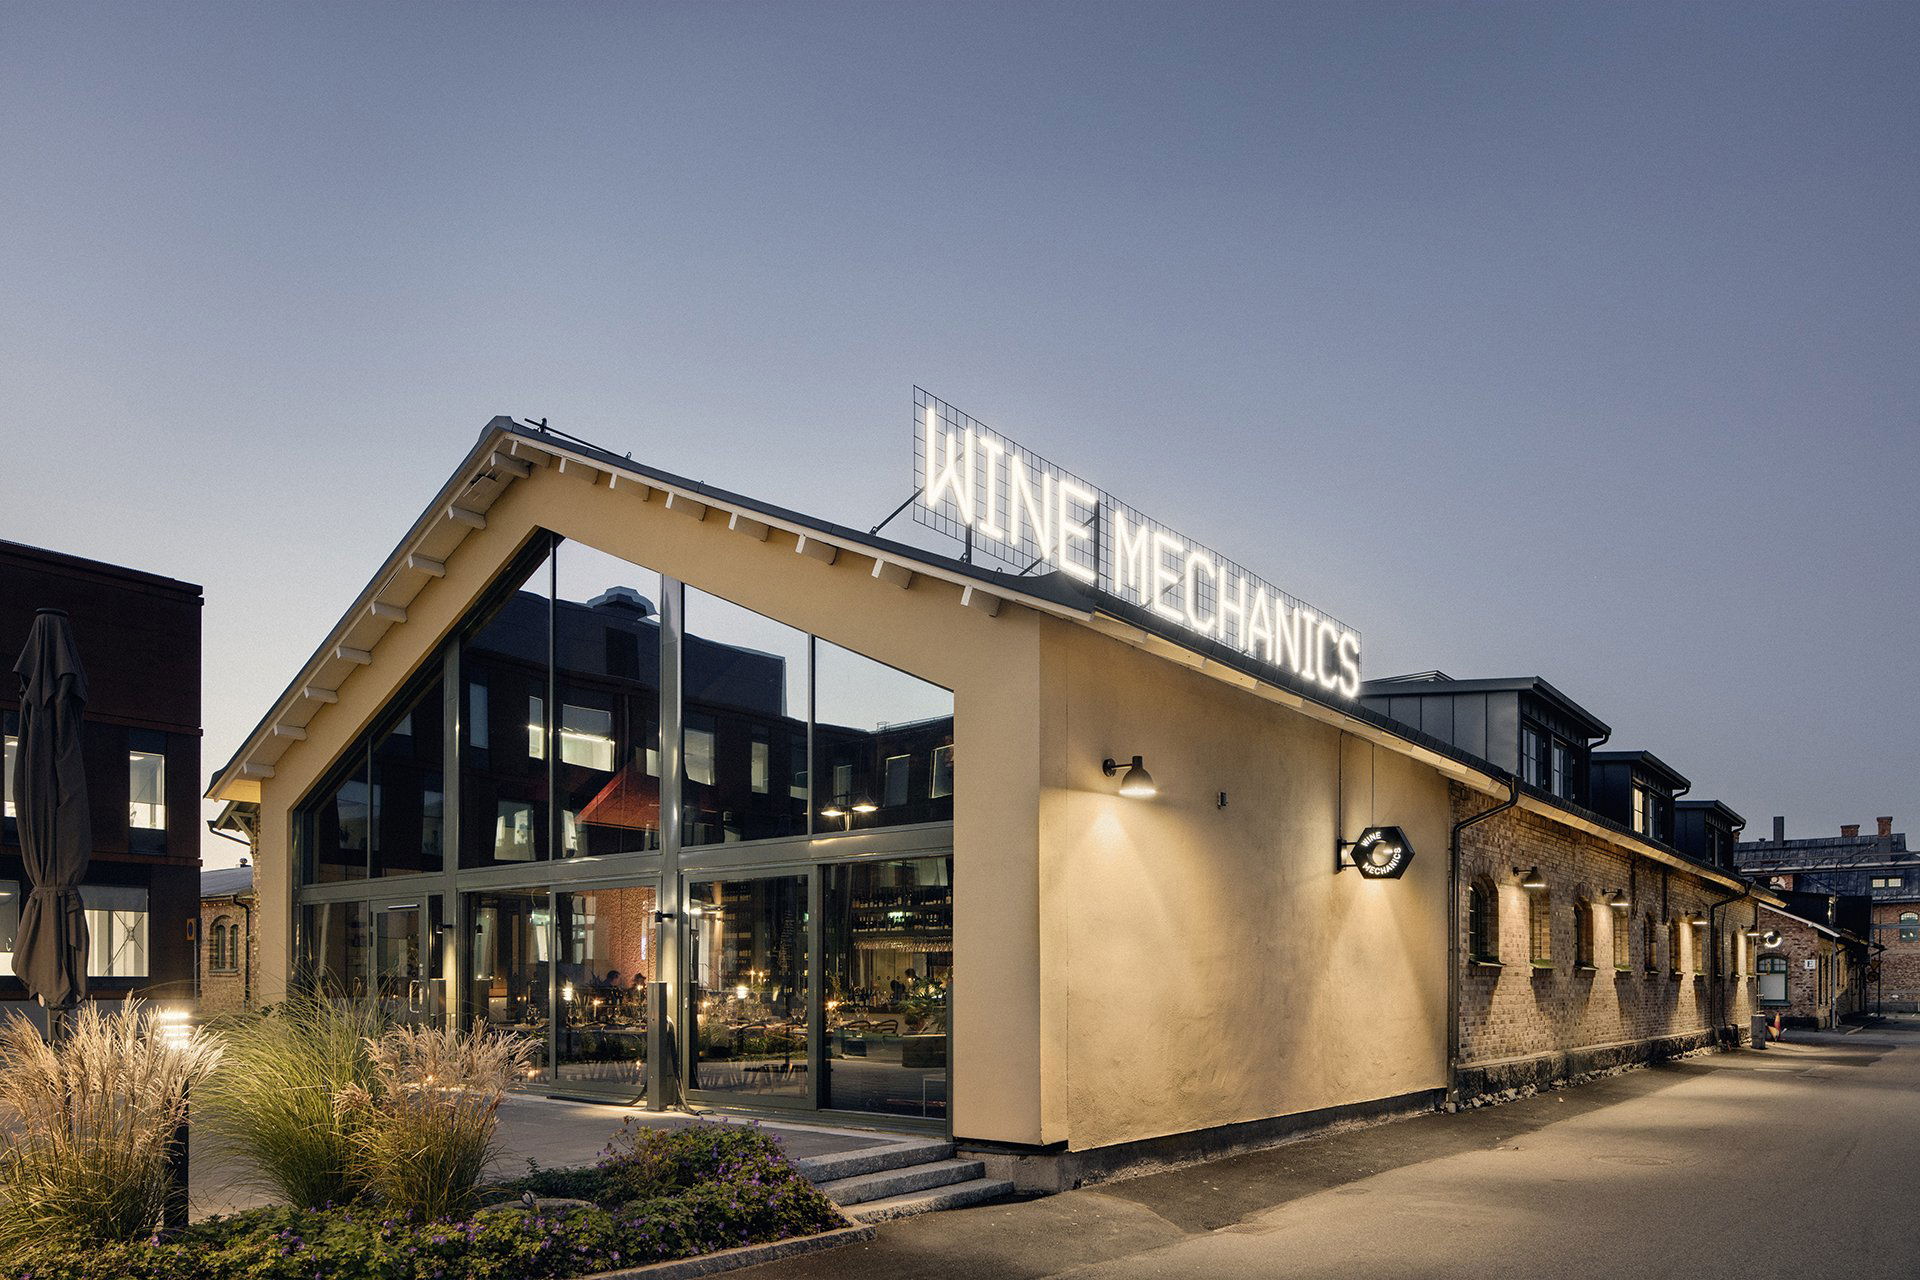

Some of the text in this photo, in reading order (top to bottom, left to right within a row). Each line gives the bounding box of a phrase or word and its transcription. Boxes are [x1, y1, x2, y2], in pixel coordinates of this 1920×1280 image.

[925, 407, 1361, 699] WINE MECHANICS
[1361, 831, 1382, 847] WINE
[1362, 847, 1402, 875] MECHANICS
